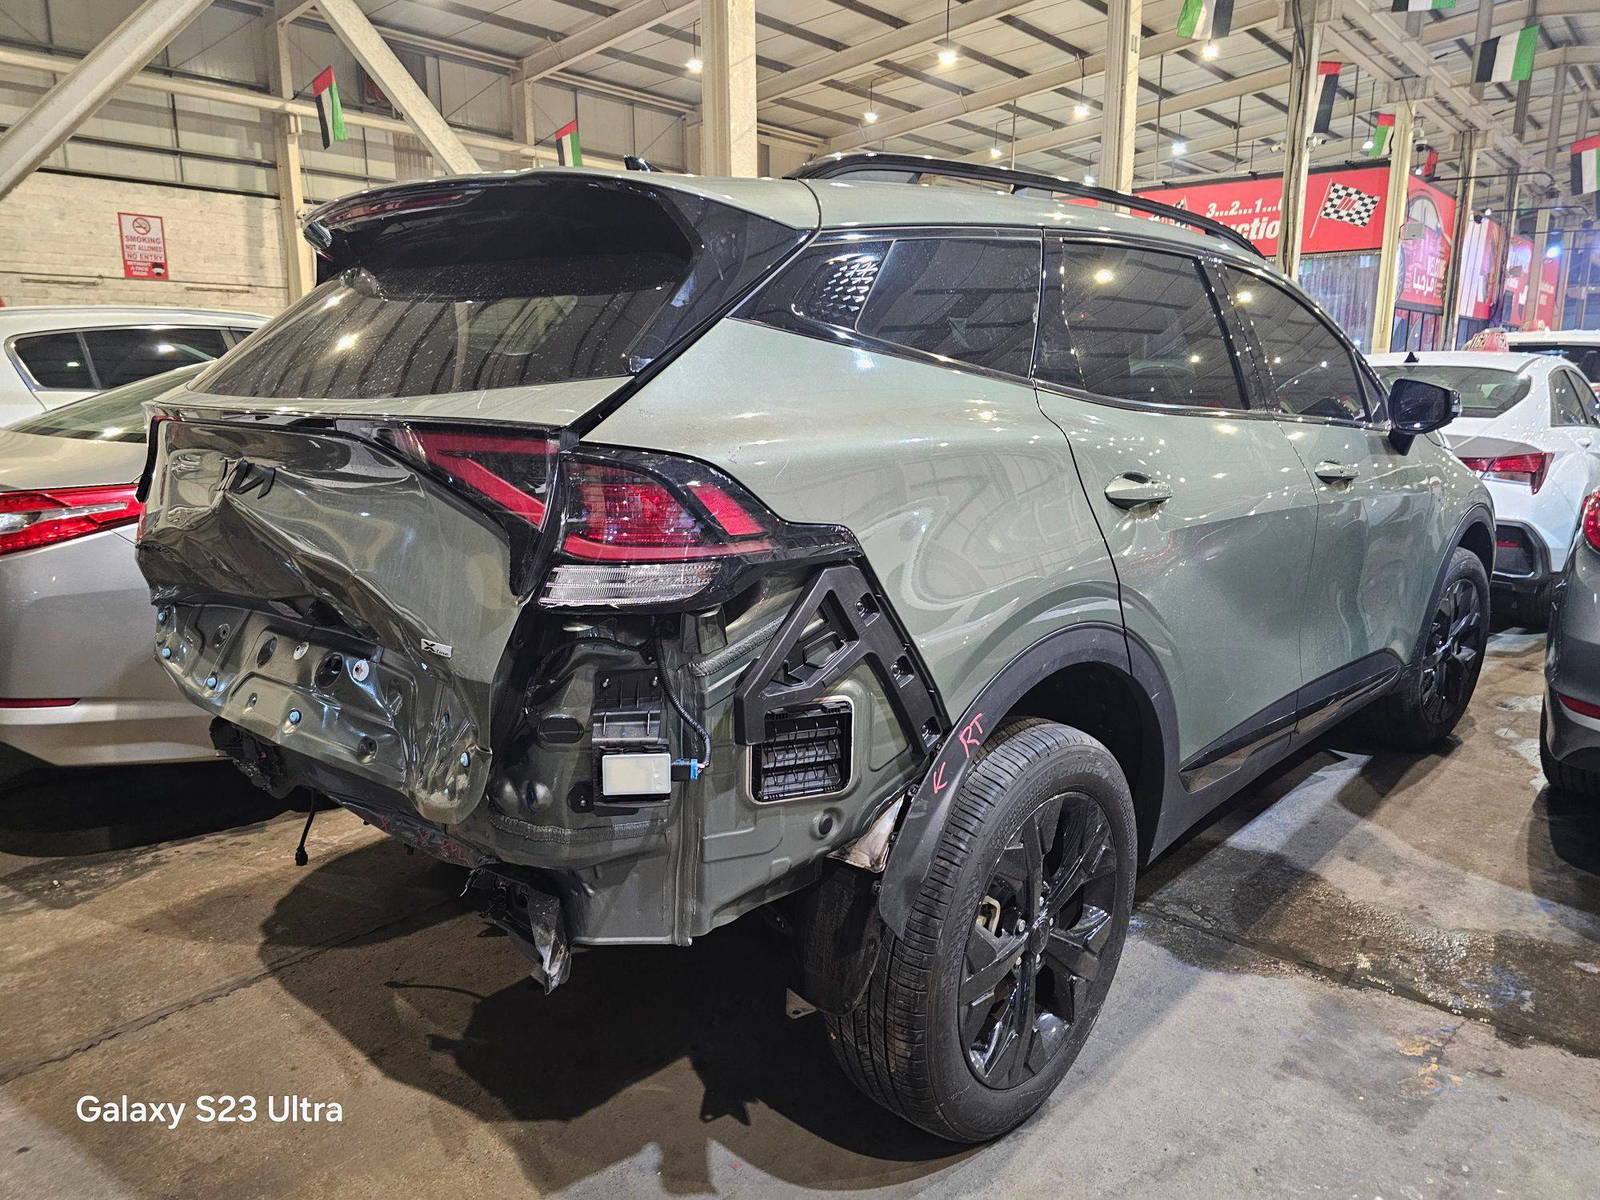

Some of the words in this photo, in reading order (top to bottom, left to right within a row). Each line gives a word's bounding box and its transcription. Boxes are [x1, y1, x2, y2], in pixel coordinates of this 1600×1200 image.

[1206, 198, 1282, 219] 3...2...1...
[125, 235, 160, 244] SMOKING
[959, 712, 984, 758] RT
